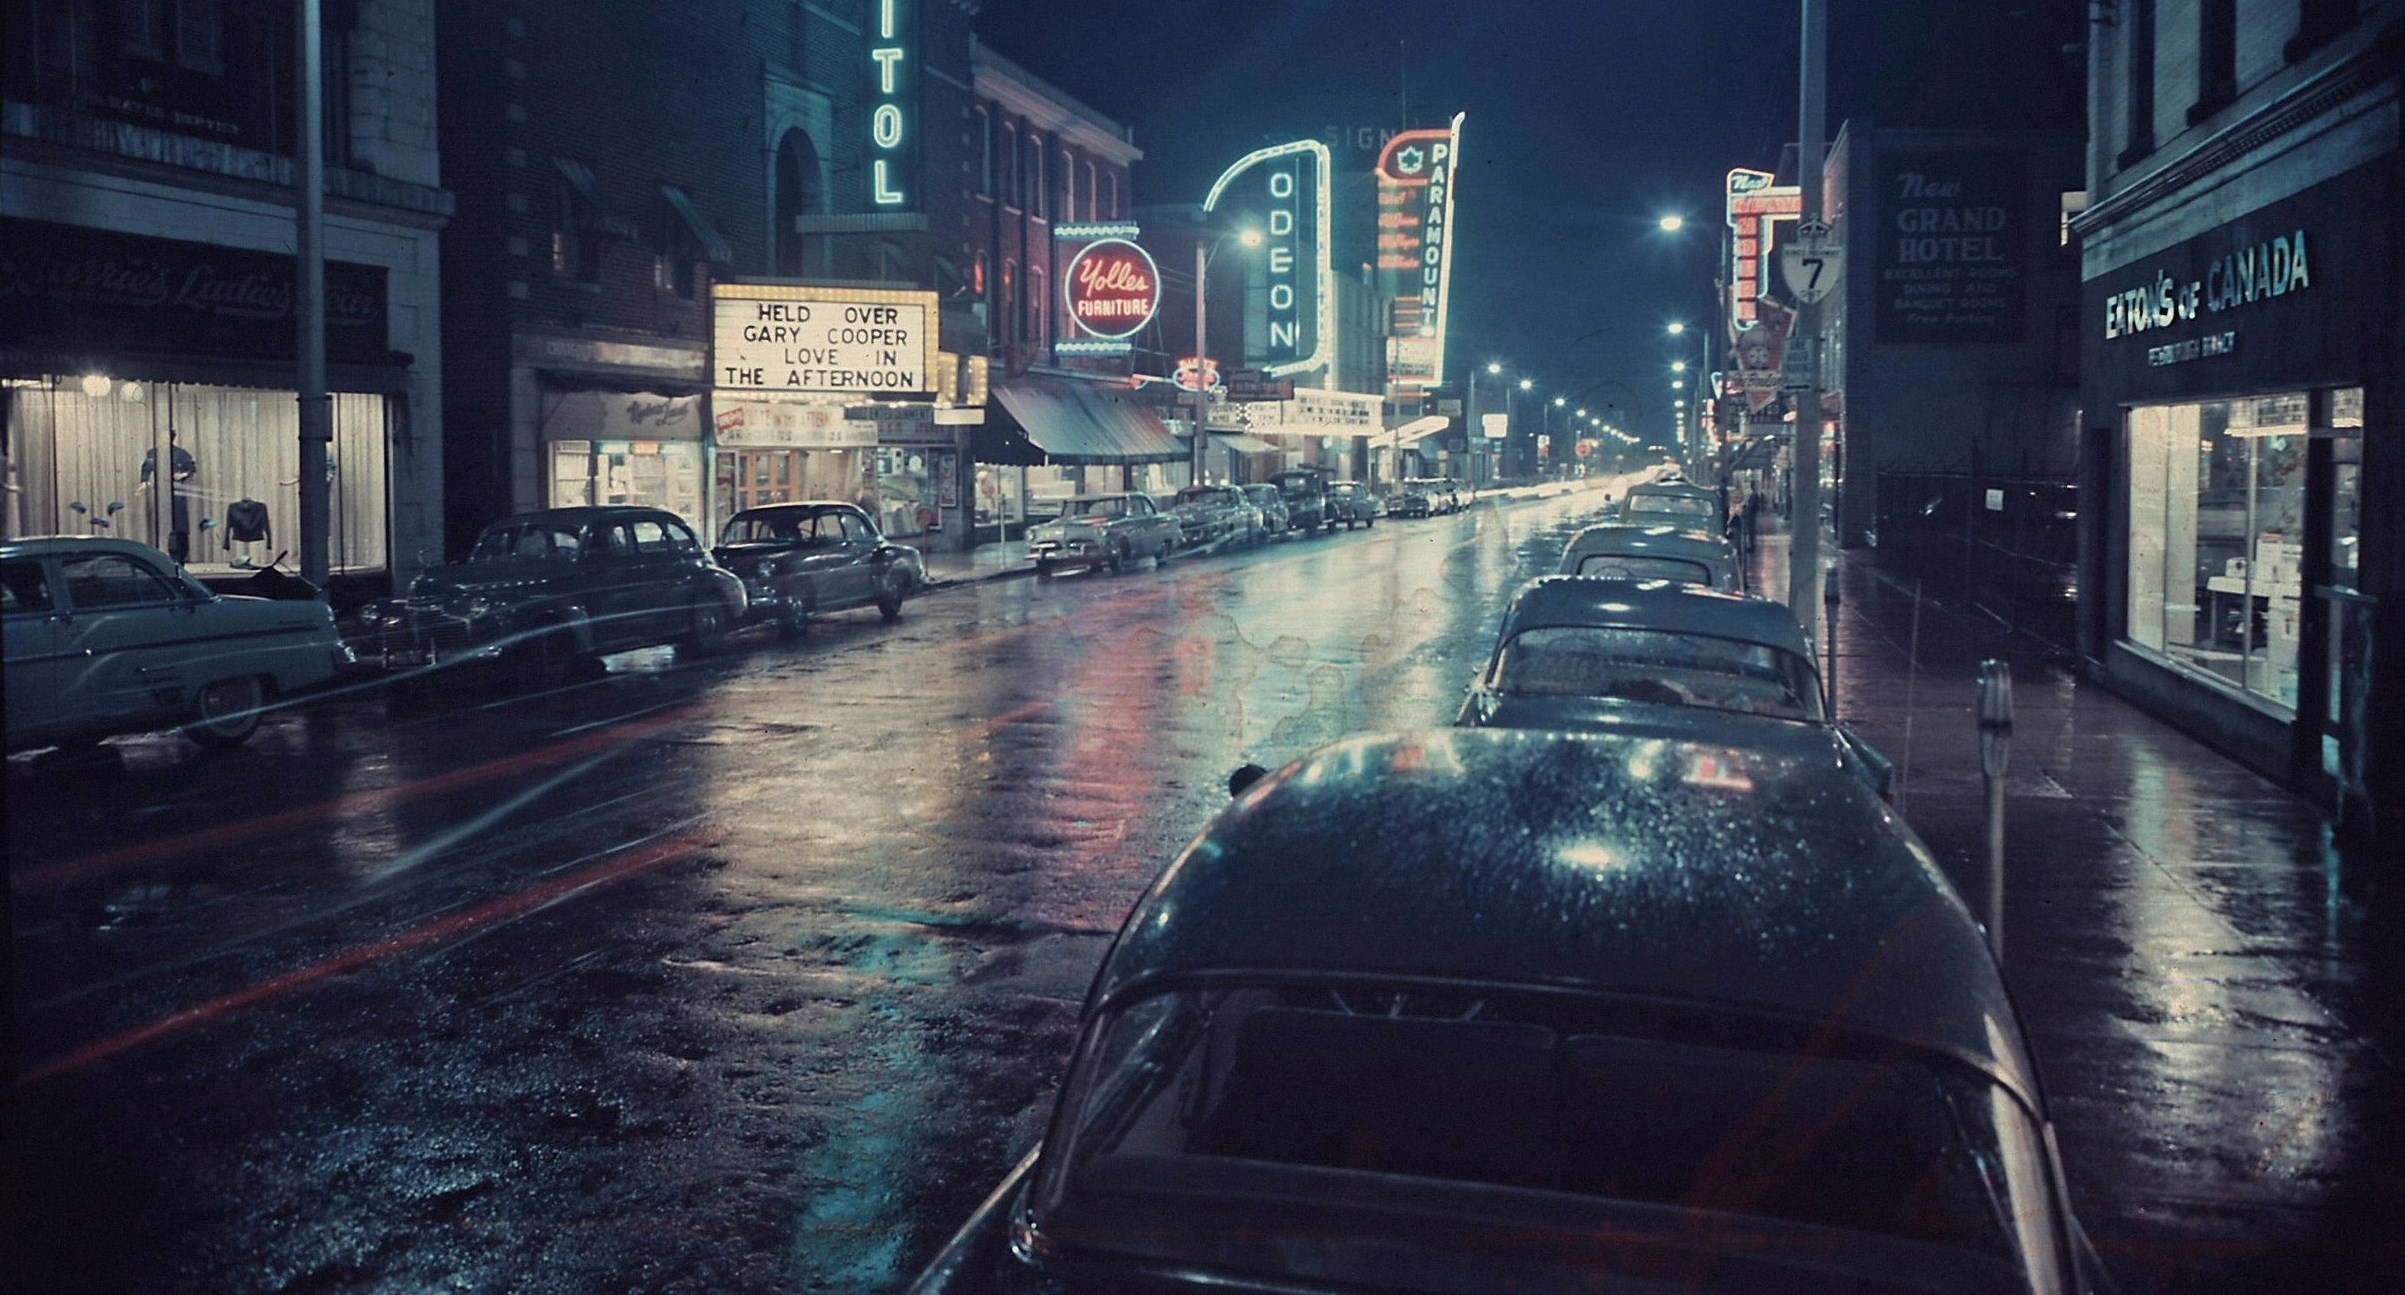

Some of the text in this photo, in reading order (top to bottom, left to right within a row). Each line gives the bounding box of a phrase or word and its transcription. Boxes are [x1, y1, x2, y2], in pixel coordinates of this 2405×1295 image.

[1897, 171, 1961, 198] New
[1896, 206, 2007, 233] GRAND
[1421, 143, 1450, 325] PARAMOUNT
[1269, 172, 1295, 348] ODEON
[1897, 236, 2007, 263] HOTEL
[1080, 258, 1149, 297] Yolles
[1803, 259, 1823, 289] 7
[2105, 228, 2310, 339] EATON'S OF CANADA
[174, 264, 291, 318] Ladies
[1964, 282, 1998, 294] AND
[758, 305, 898, 325] HELD OVER
[1078, 298, 1150, 317] FURNITURE
[744, 325, 907, 346] GARY COOPER
[784, 348, 896, 367] LOVE IN
[725, 368, 913, 388] THE AFTERNOON
